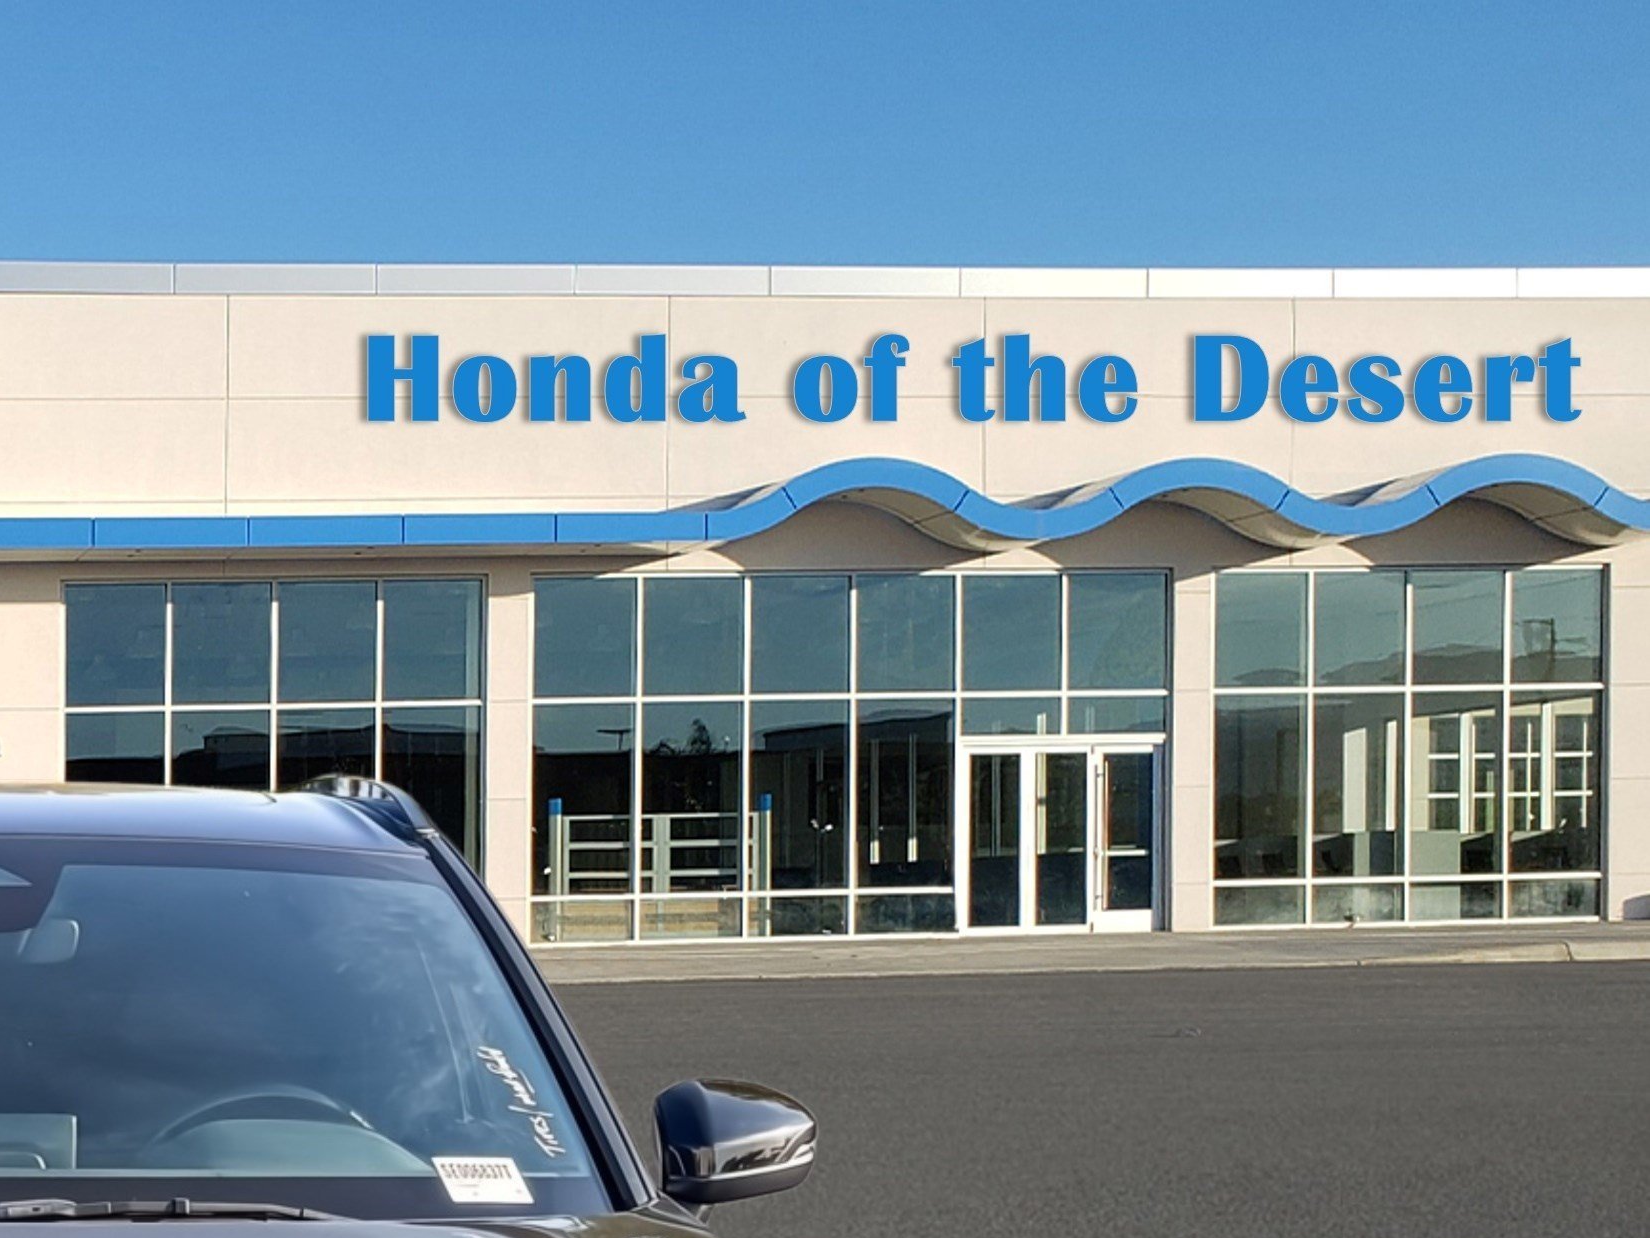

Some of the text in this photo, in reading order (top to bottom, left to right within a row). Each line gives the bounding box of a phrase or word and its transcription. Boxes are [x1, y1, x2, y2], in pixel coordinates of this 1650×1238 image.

[365, 333, 1582, 423] Honda of the Desert
